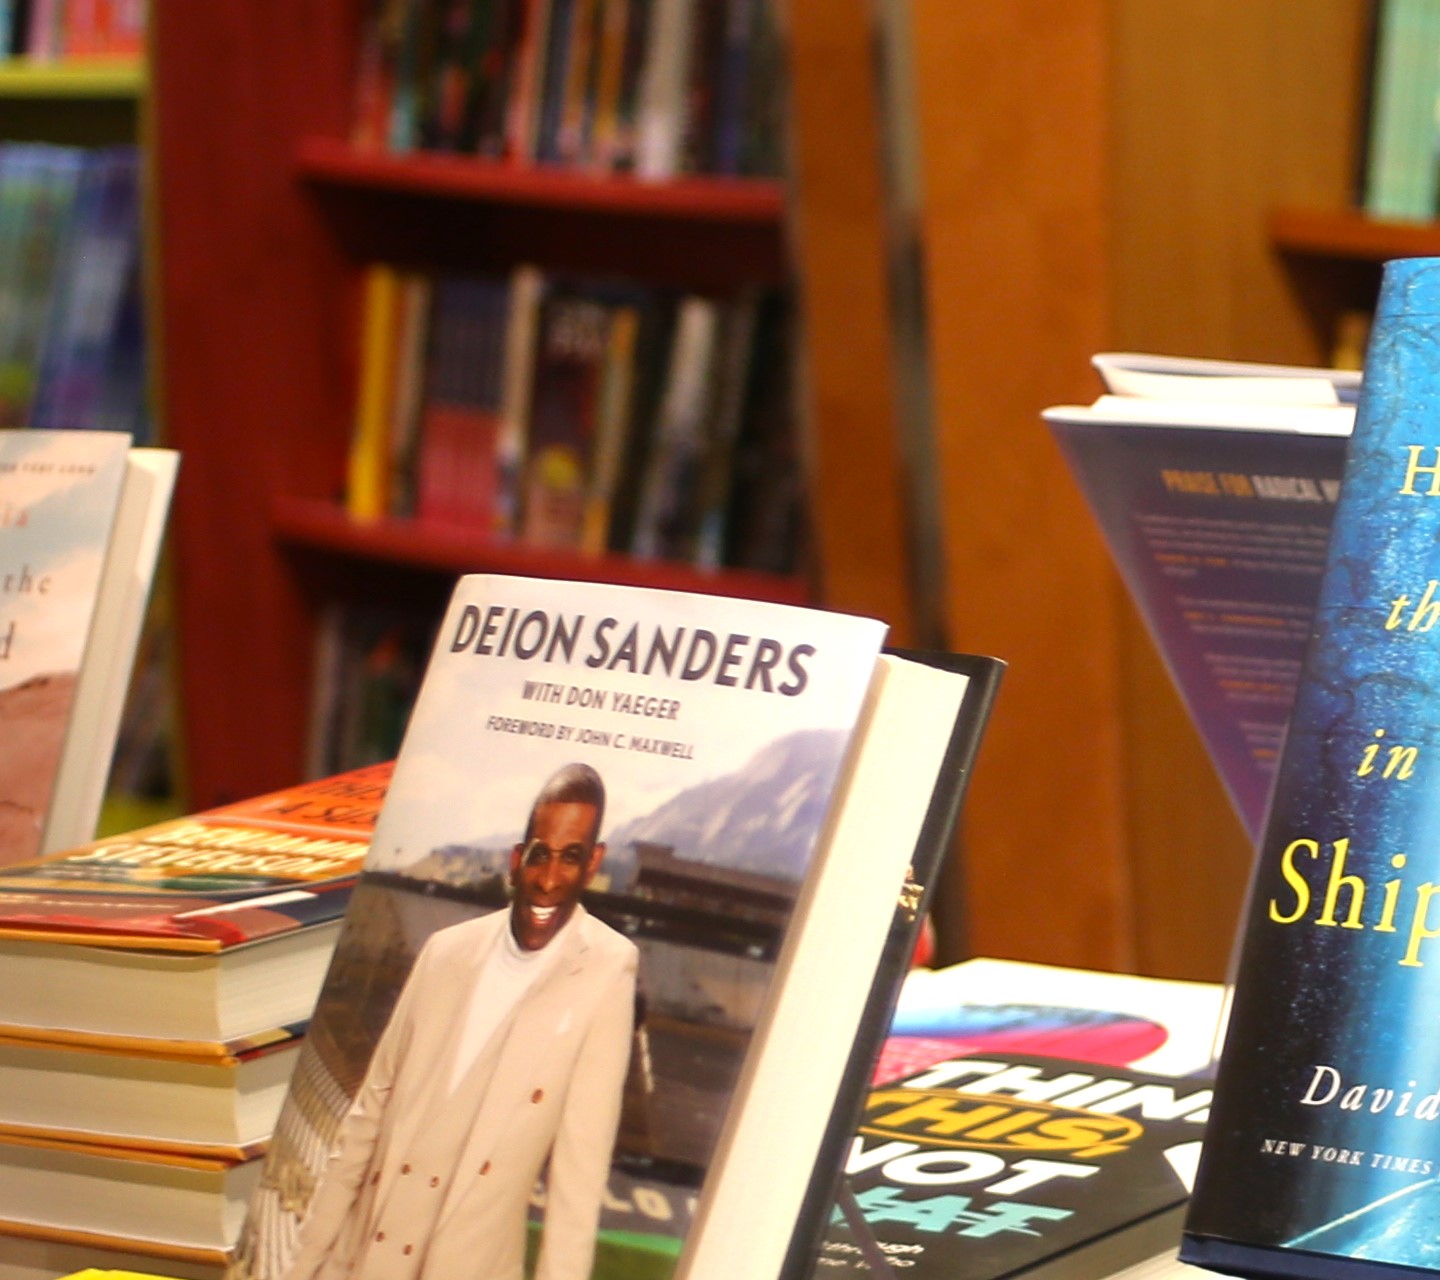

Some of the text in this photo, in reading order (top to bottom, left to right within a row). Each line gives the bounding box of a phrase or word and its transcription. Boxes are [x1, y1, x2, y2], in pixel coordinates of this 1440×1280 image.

[2, 564, 51, 594] the
[450, 604, 817, 698] DEION SANDERS
[521, 680, 681, 721] WITH DON YAEGER
[485, 715, 694, 761] FOREWORD BY JOHN C. MAXWELL
[1357, 726, 1418, 781] in
[1260, 1137, 1308, 1159] NEW
[1310, 1142, 1366, 1169] YORK
[1371, 1153, 1434, 1178] TIMES
